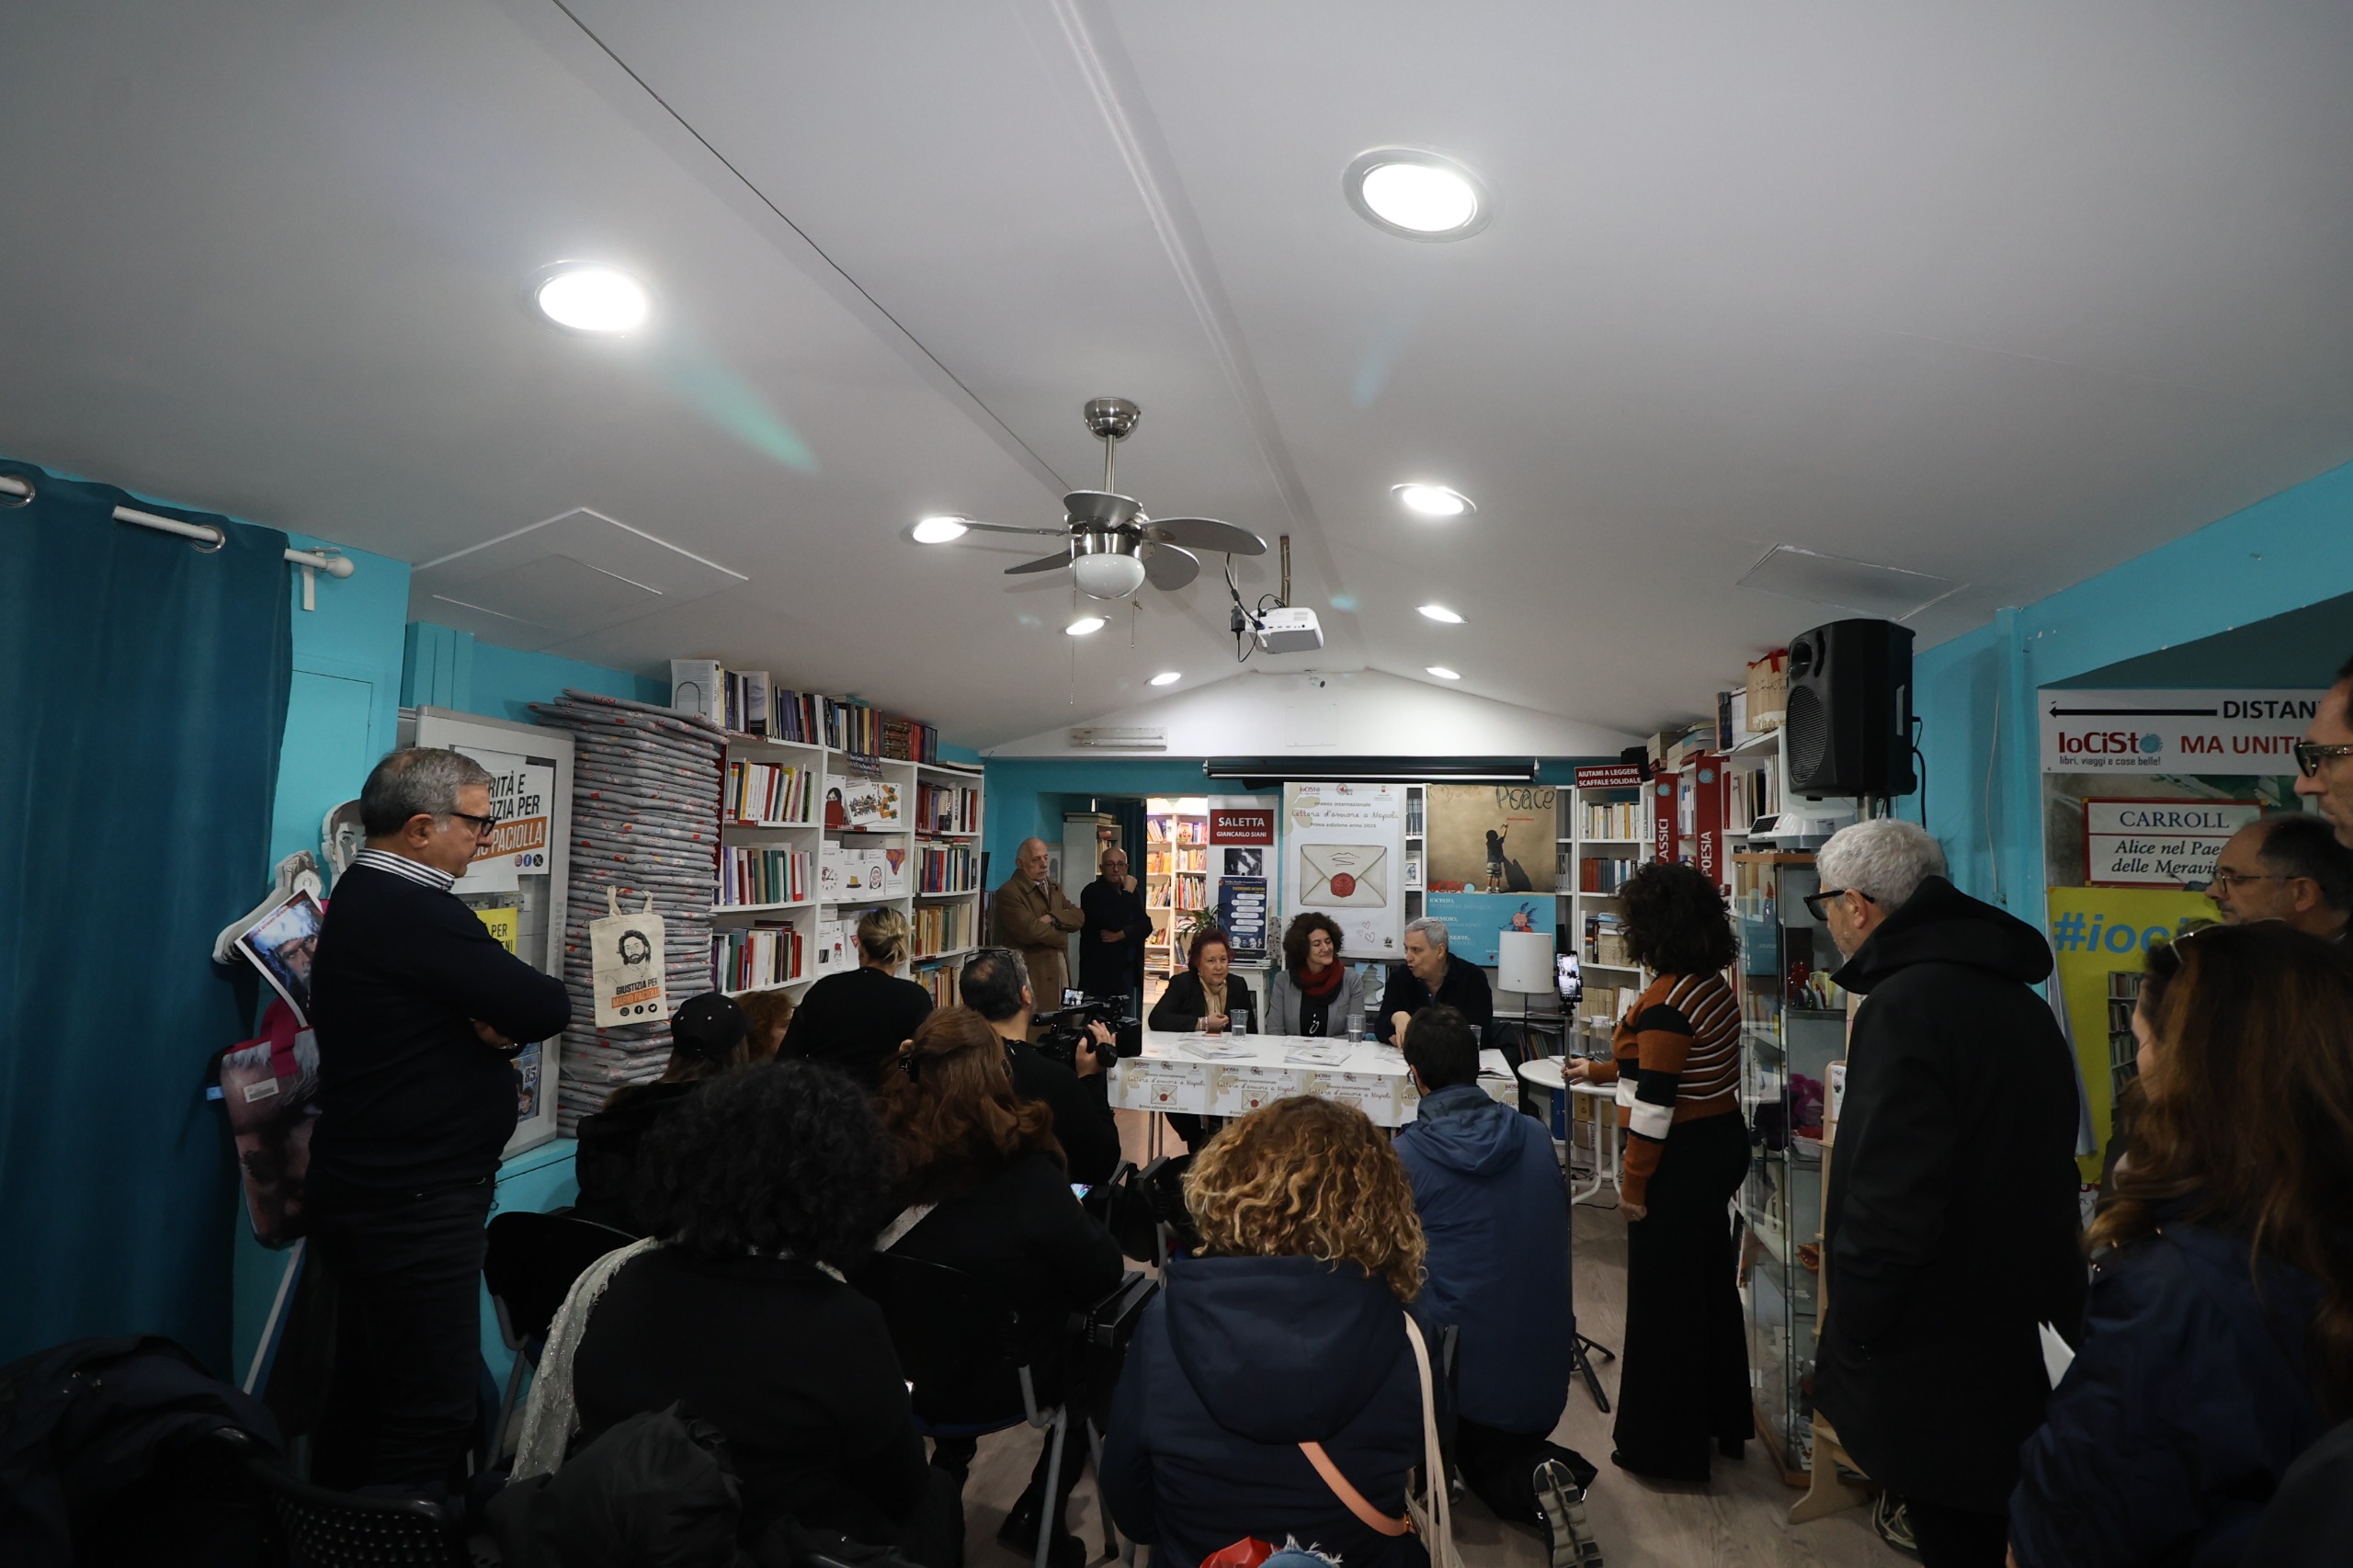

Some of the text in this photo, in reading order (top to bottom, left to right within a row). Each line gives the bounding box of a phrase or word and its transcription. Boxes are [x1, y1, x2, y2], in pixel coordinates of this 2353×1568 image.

[2223, 701, 2321, 719] DISTAN
[2181, 736, 2224, 754] MA
[2081, 757, 2105, 767] viaggi
[489, 770, 526, 798] RITÀ E
[517, 795, 540, 817] PER
[1495, 785, 1555, 810] Peace
[1218, 817, 1265, 827] SALETTA
[1372, 811, 1399, 821] Napoli
[2120, 811, 2230, 828] CARROLL
[491, 821, 543, 854] PACIOLLA
[1659, 818, 1669, 863] ASSICI
[1700, 831, 1712, 877] POESIA
[2114, 839, 2221, 856] Alice nel Pae
[2111, 858, 2149, 873] delle
[492, 924, 507, 937] PER
[616, 980, 647, 995] GIUSTIZIA
[524, 1066, 537, 1083] 85
